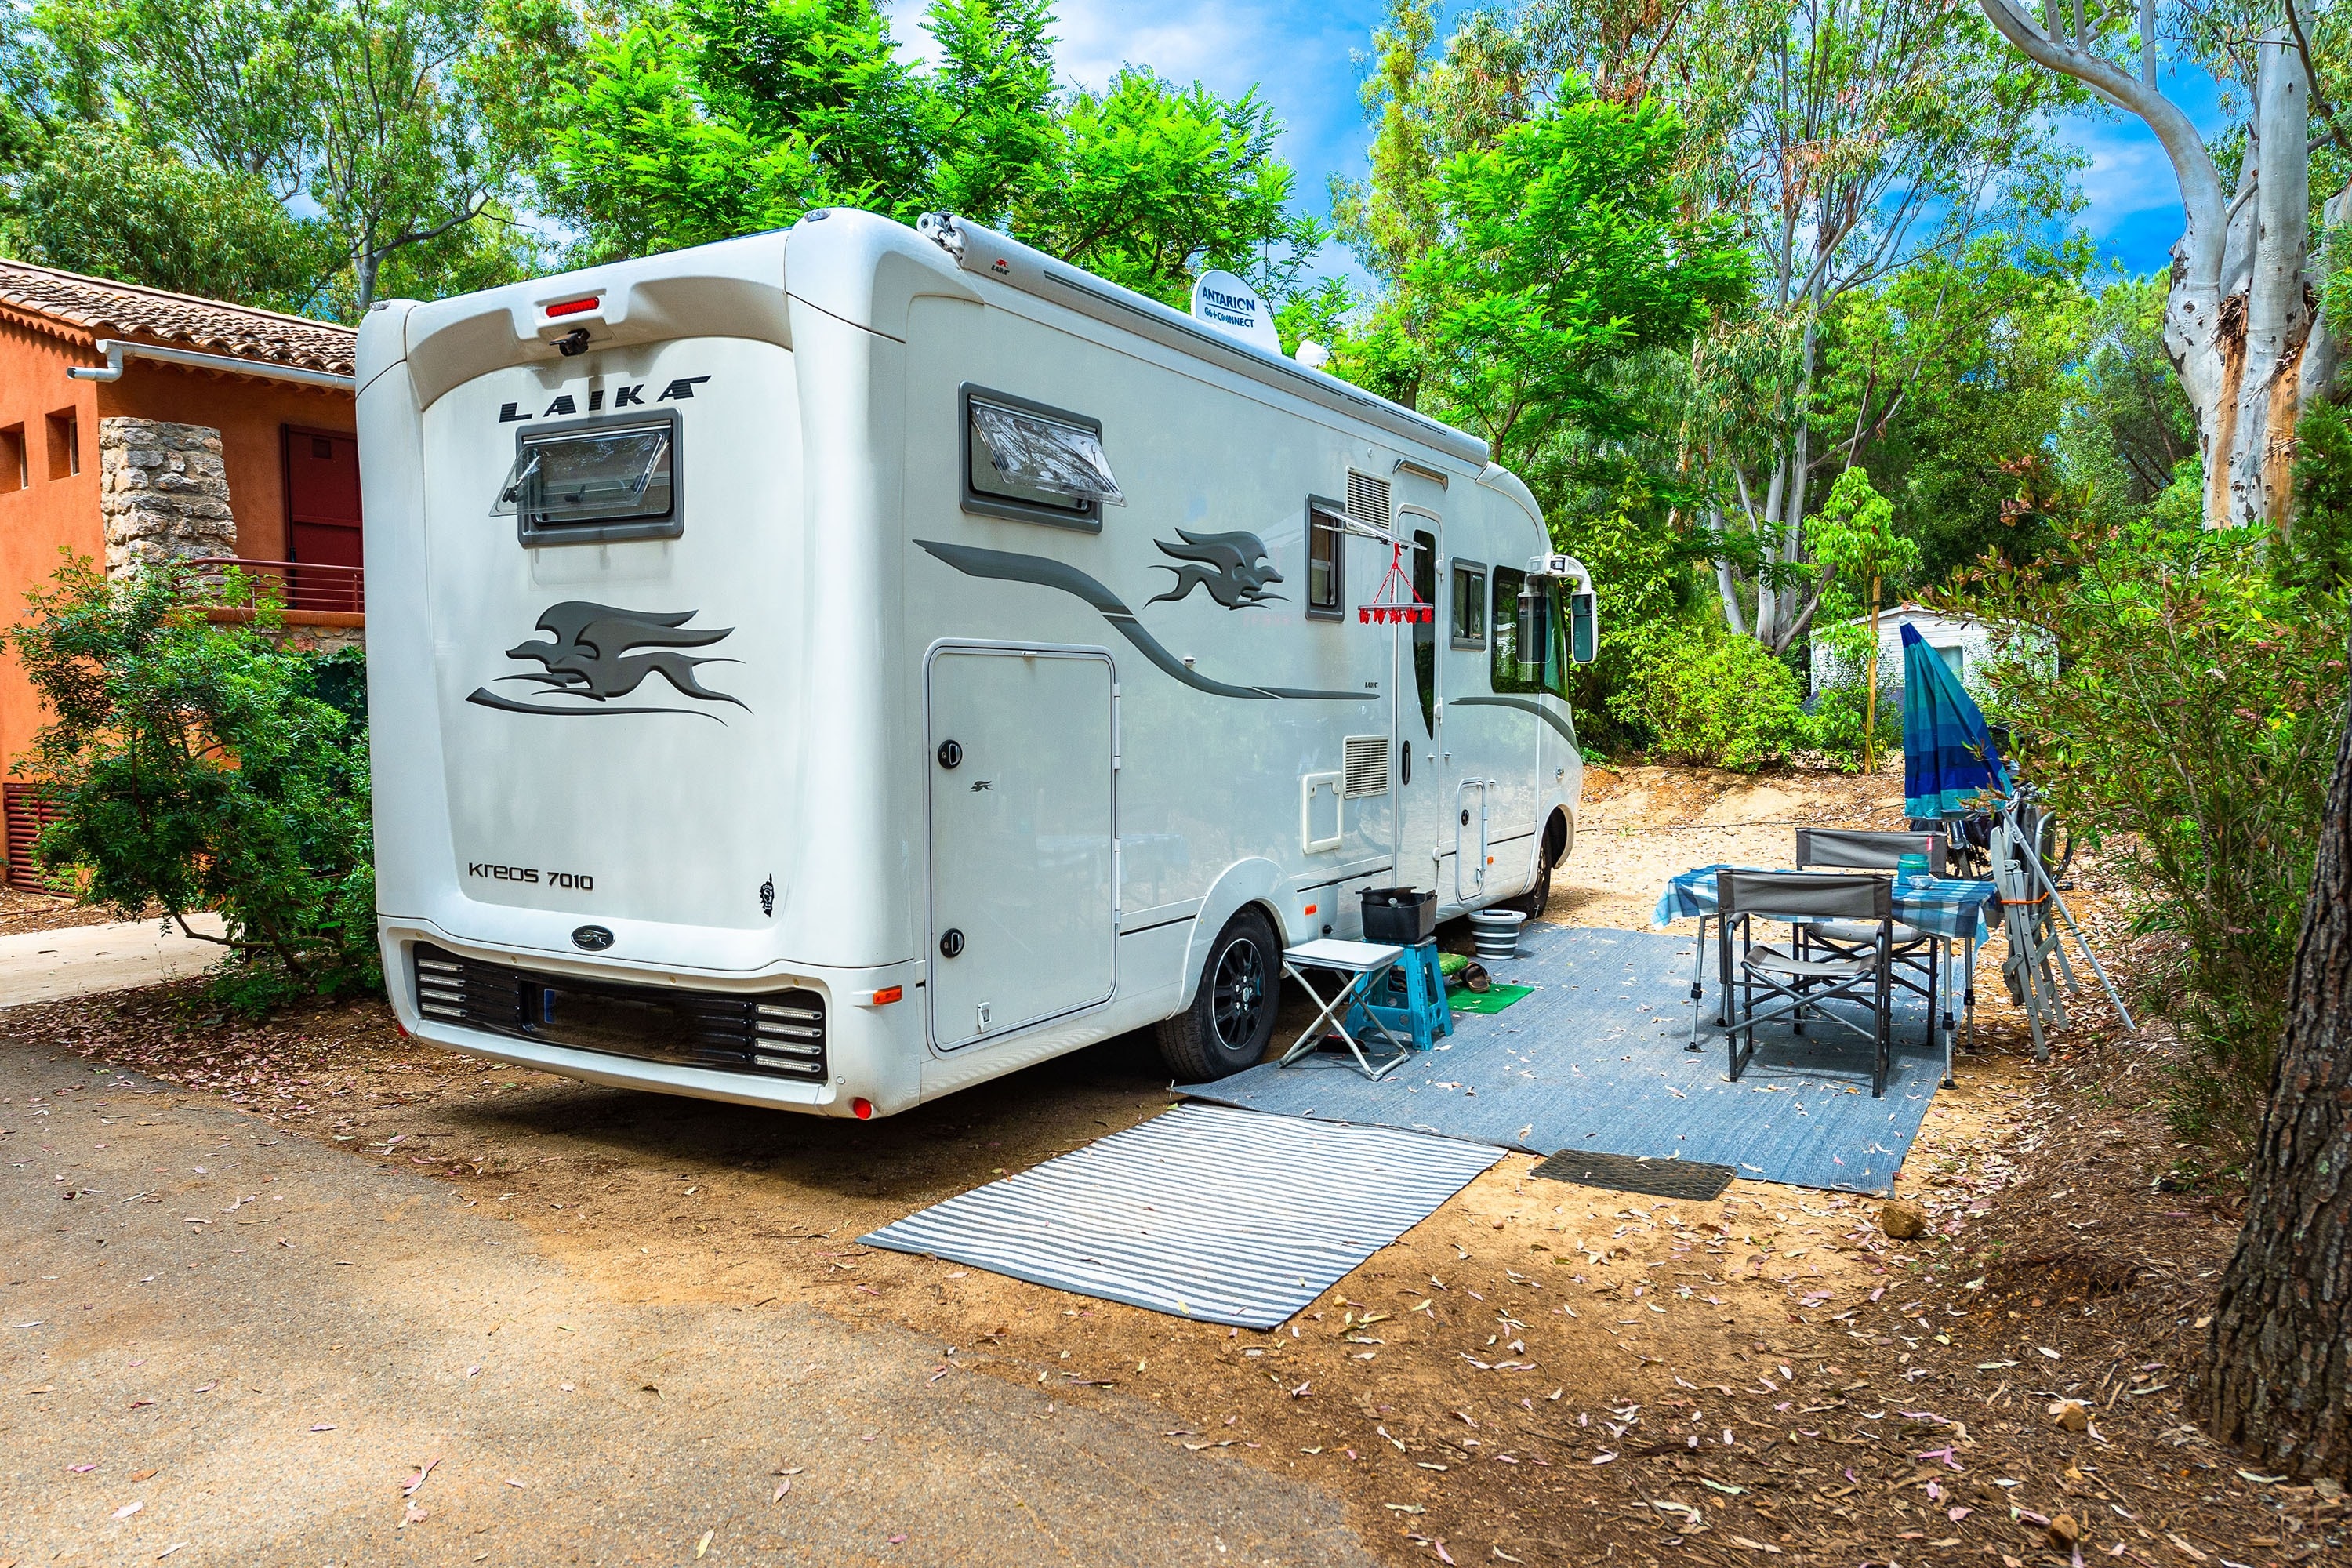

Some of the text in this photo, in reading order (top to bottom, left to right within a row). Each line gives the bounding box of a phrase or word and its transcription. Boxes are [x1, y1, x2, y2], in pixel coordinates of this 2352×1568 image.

[1202, 286, 1255, 312] ANTARION
[499, 375, 712, 423] LAIKA
[546, 871, 593, 891] 7010
